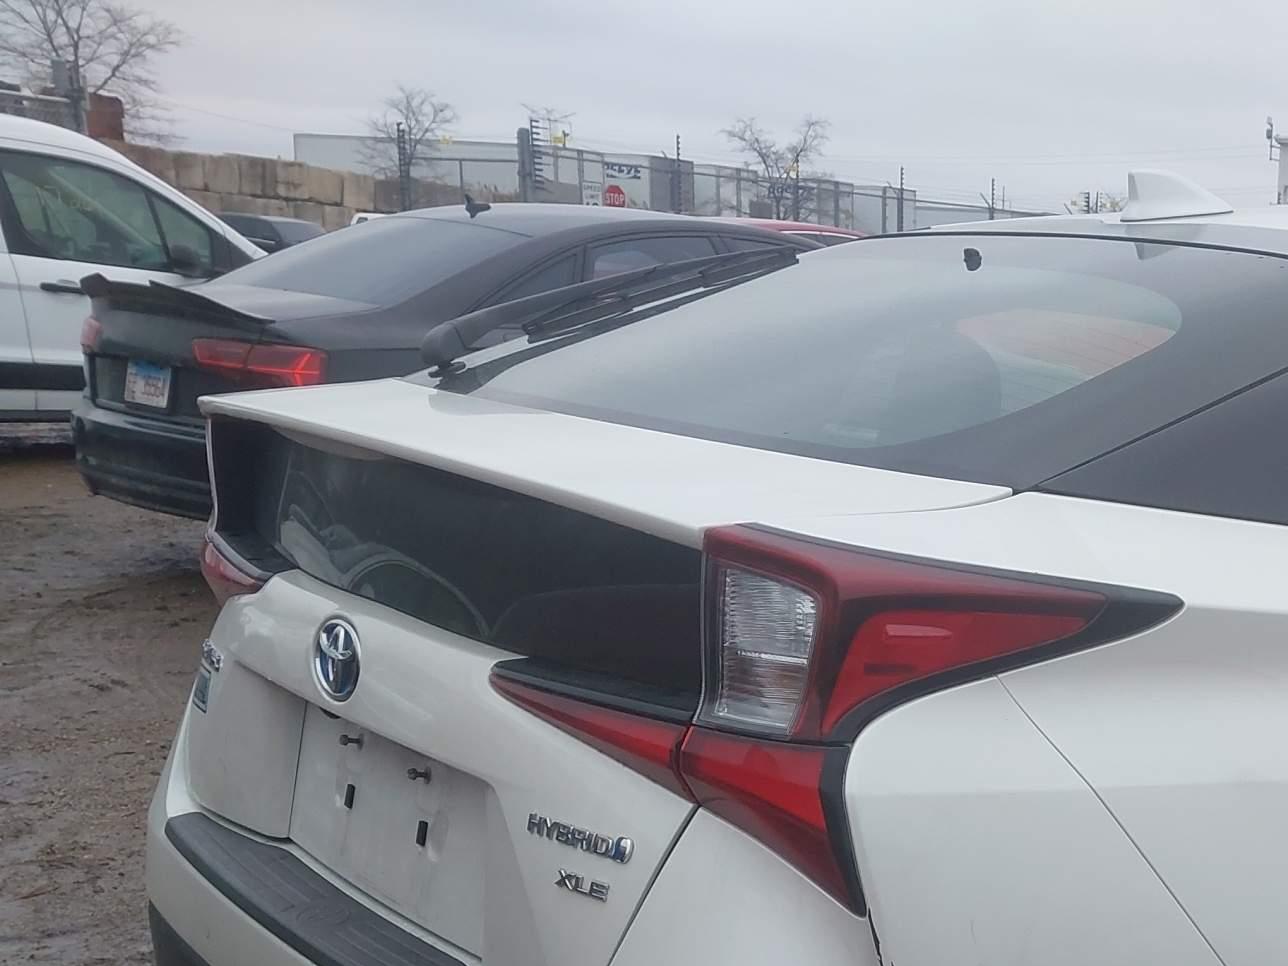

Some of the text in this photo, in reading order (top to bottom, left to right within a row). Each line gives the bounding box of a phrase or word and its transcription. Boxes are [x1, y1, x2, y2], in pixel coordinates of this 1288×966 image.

[604, 193, 625, 205] STOP
[527, 812, 613, 857] HYBRID
[553, 867, 611, 903] XLE
